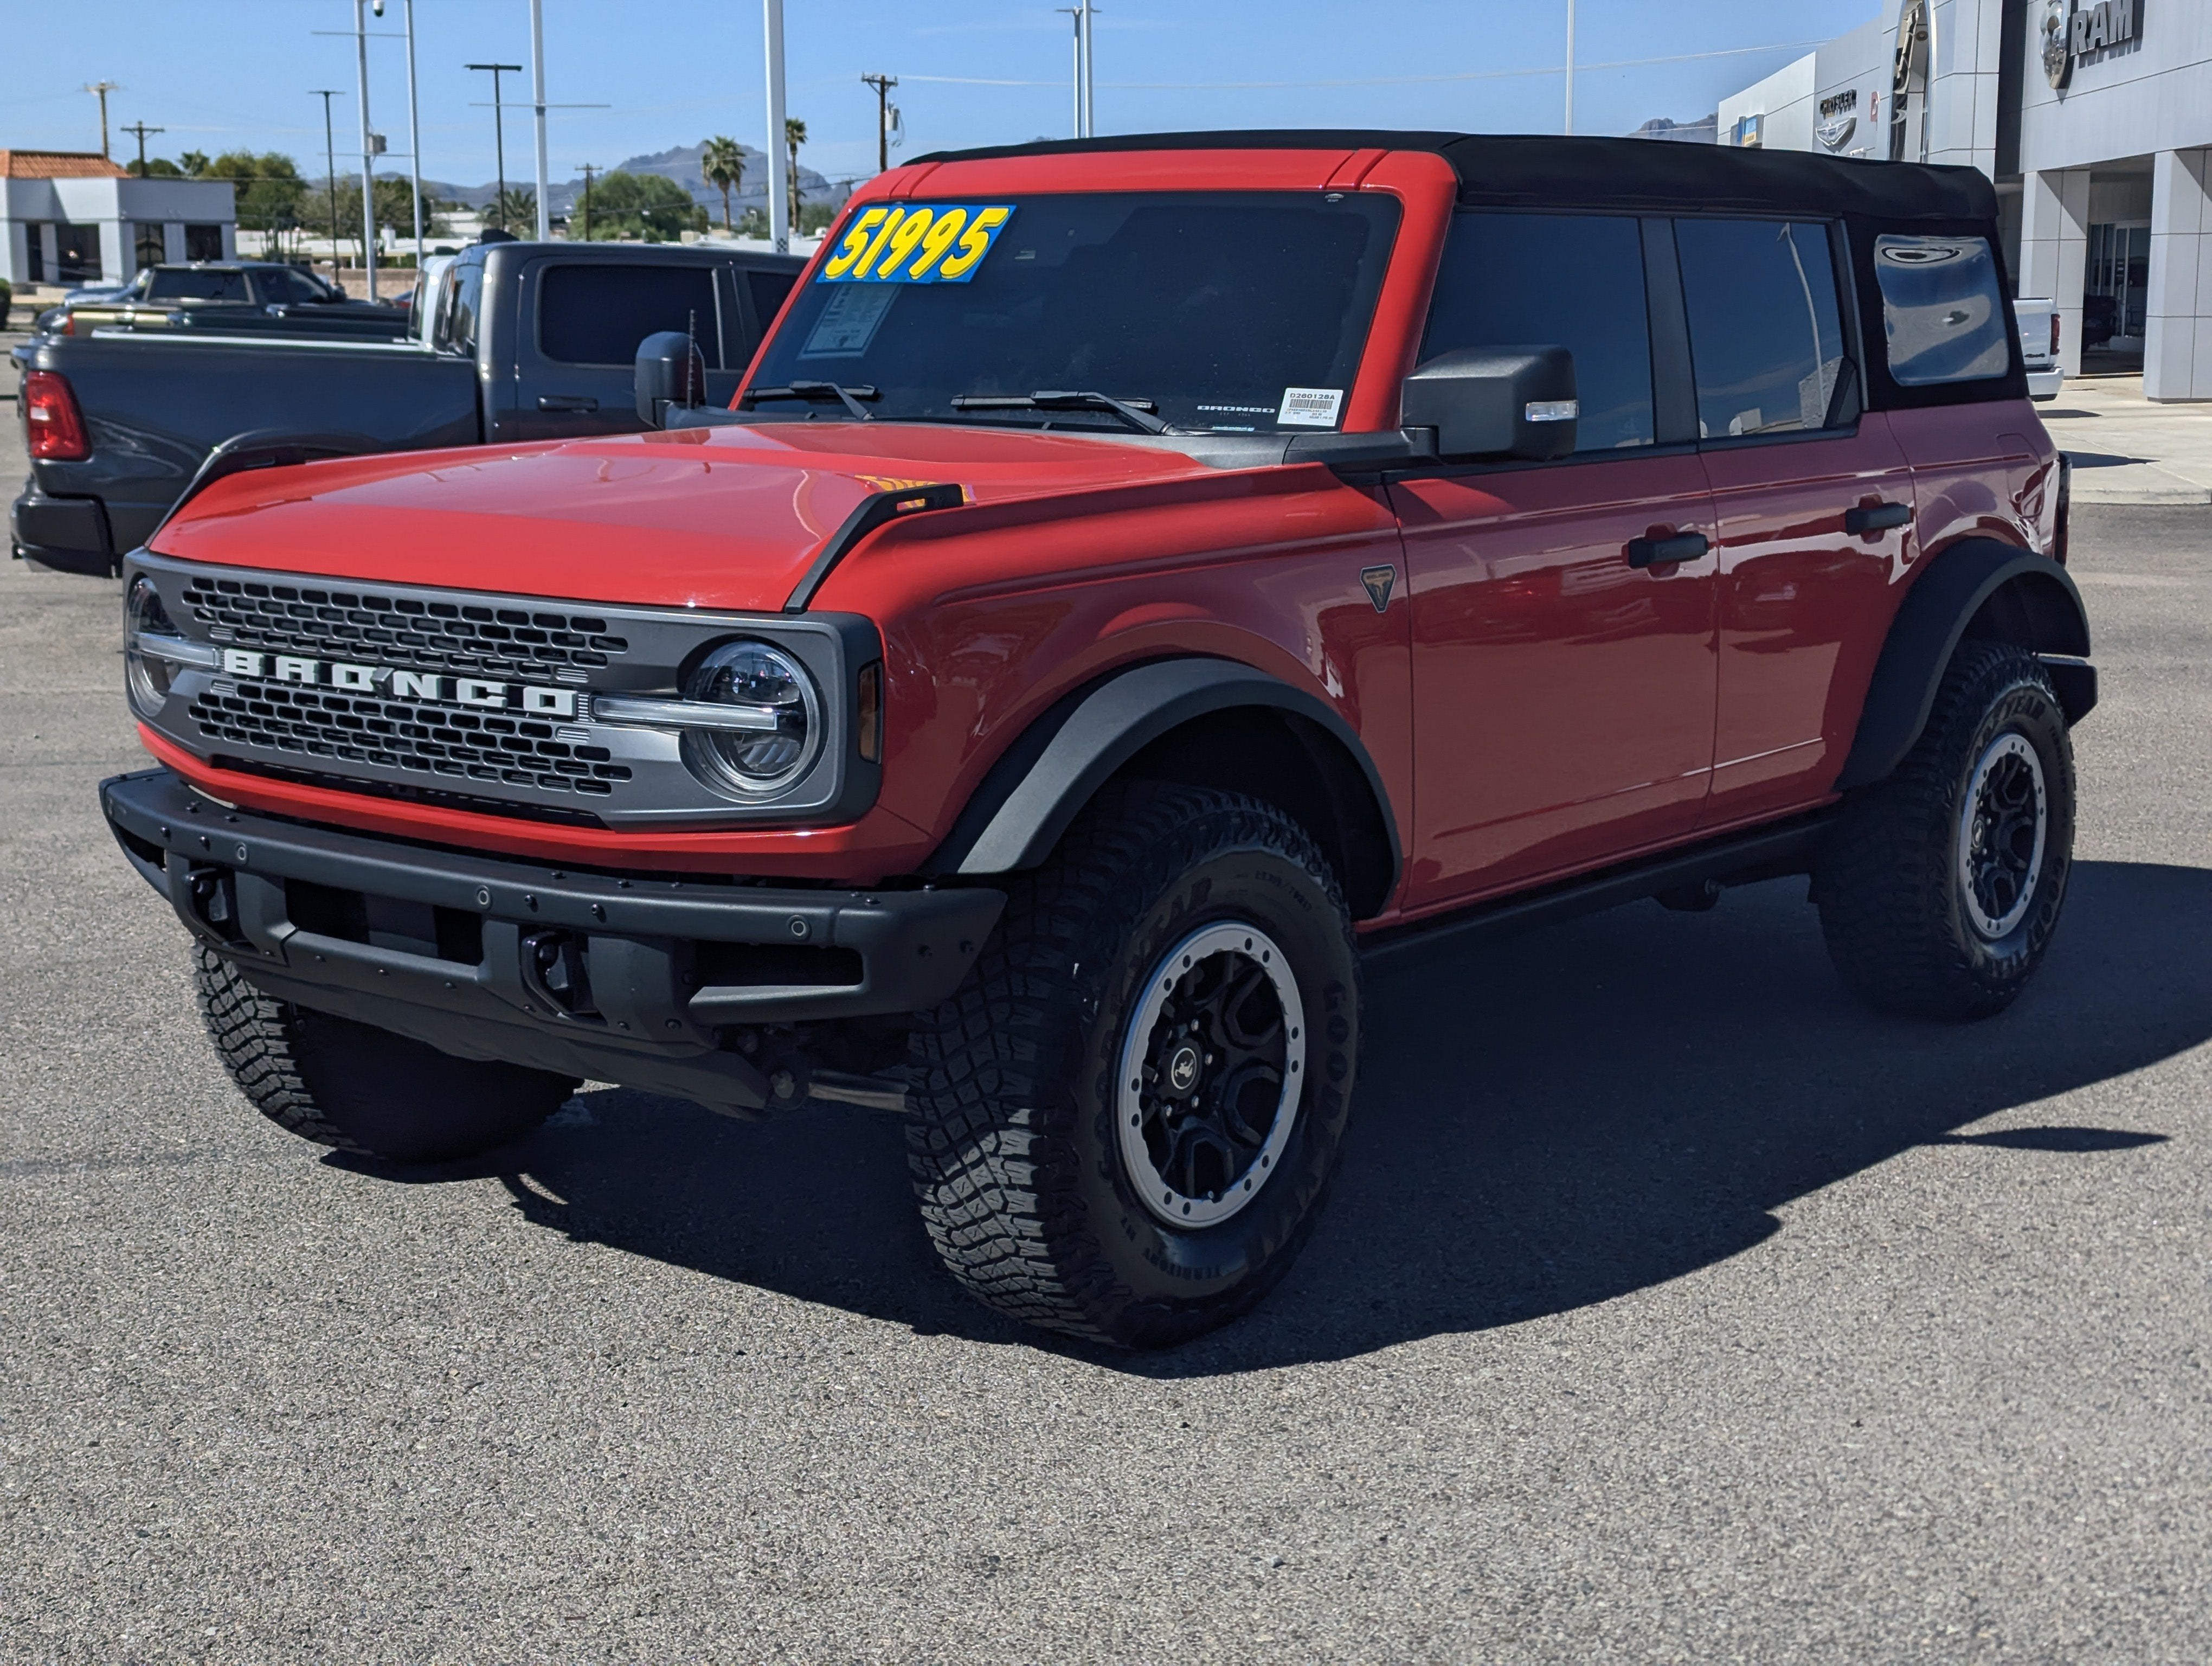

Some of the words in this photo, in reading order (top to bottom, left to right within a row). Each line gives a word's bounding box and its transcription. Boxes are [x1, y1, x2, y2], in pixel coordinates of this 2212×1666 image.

[2070, 0, 2133, 56] RAM
[824, 207, 1010, 280] 51995
[224, 648, 578, 716] BRONCO
